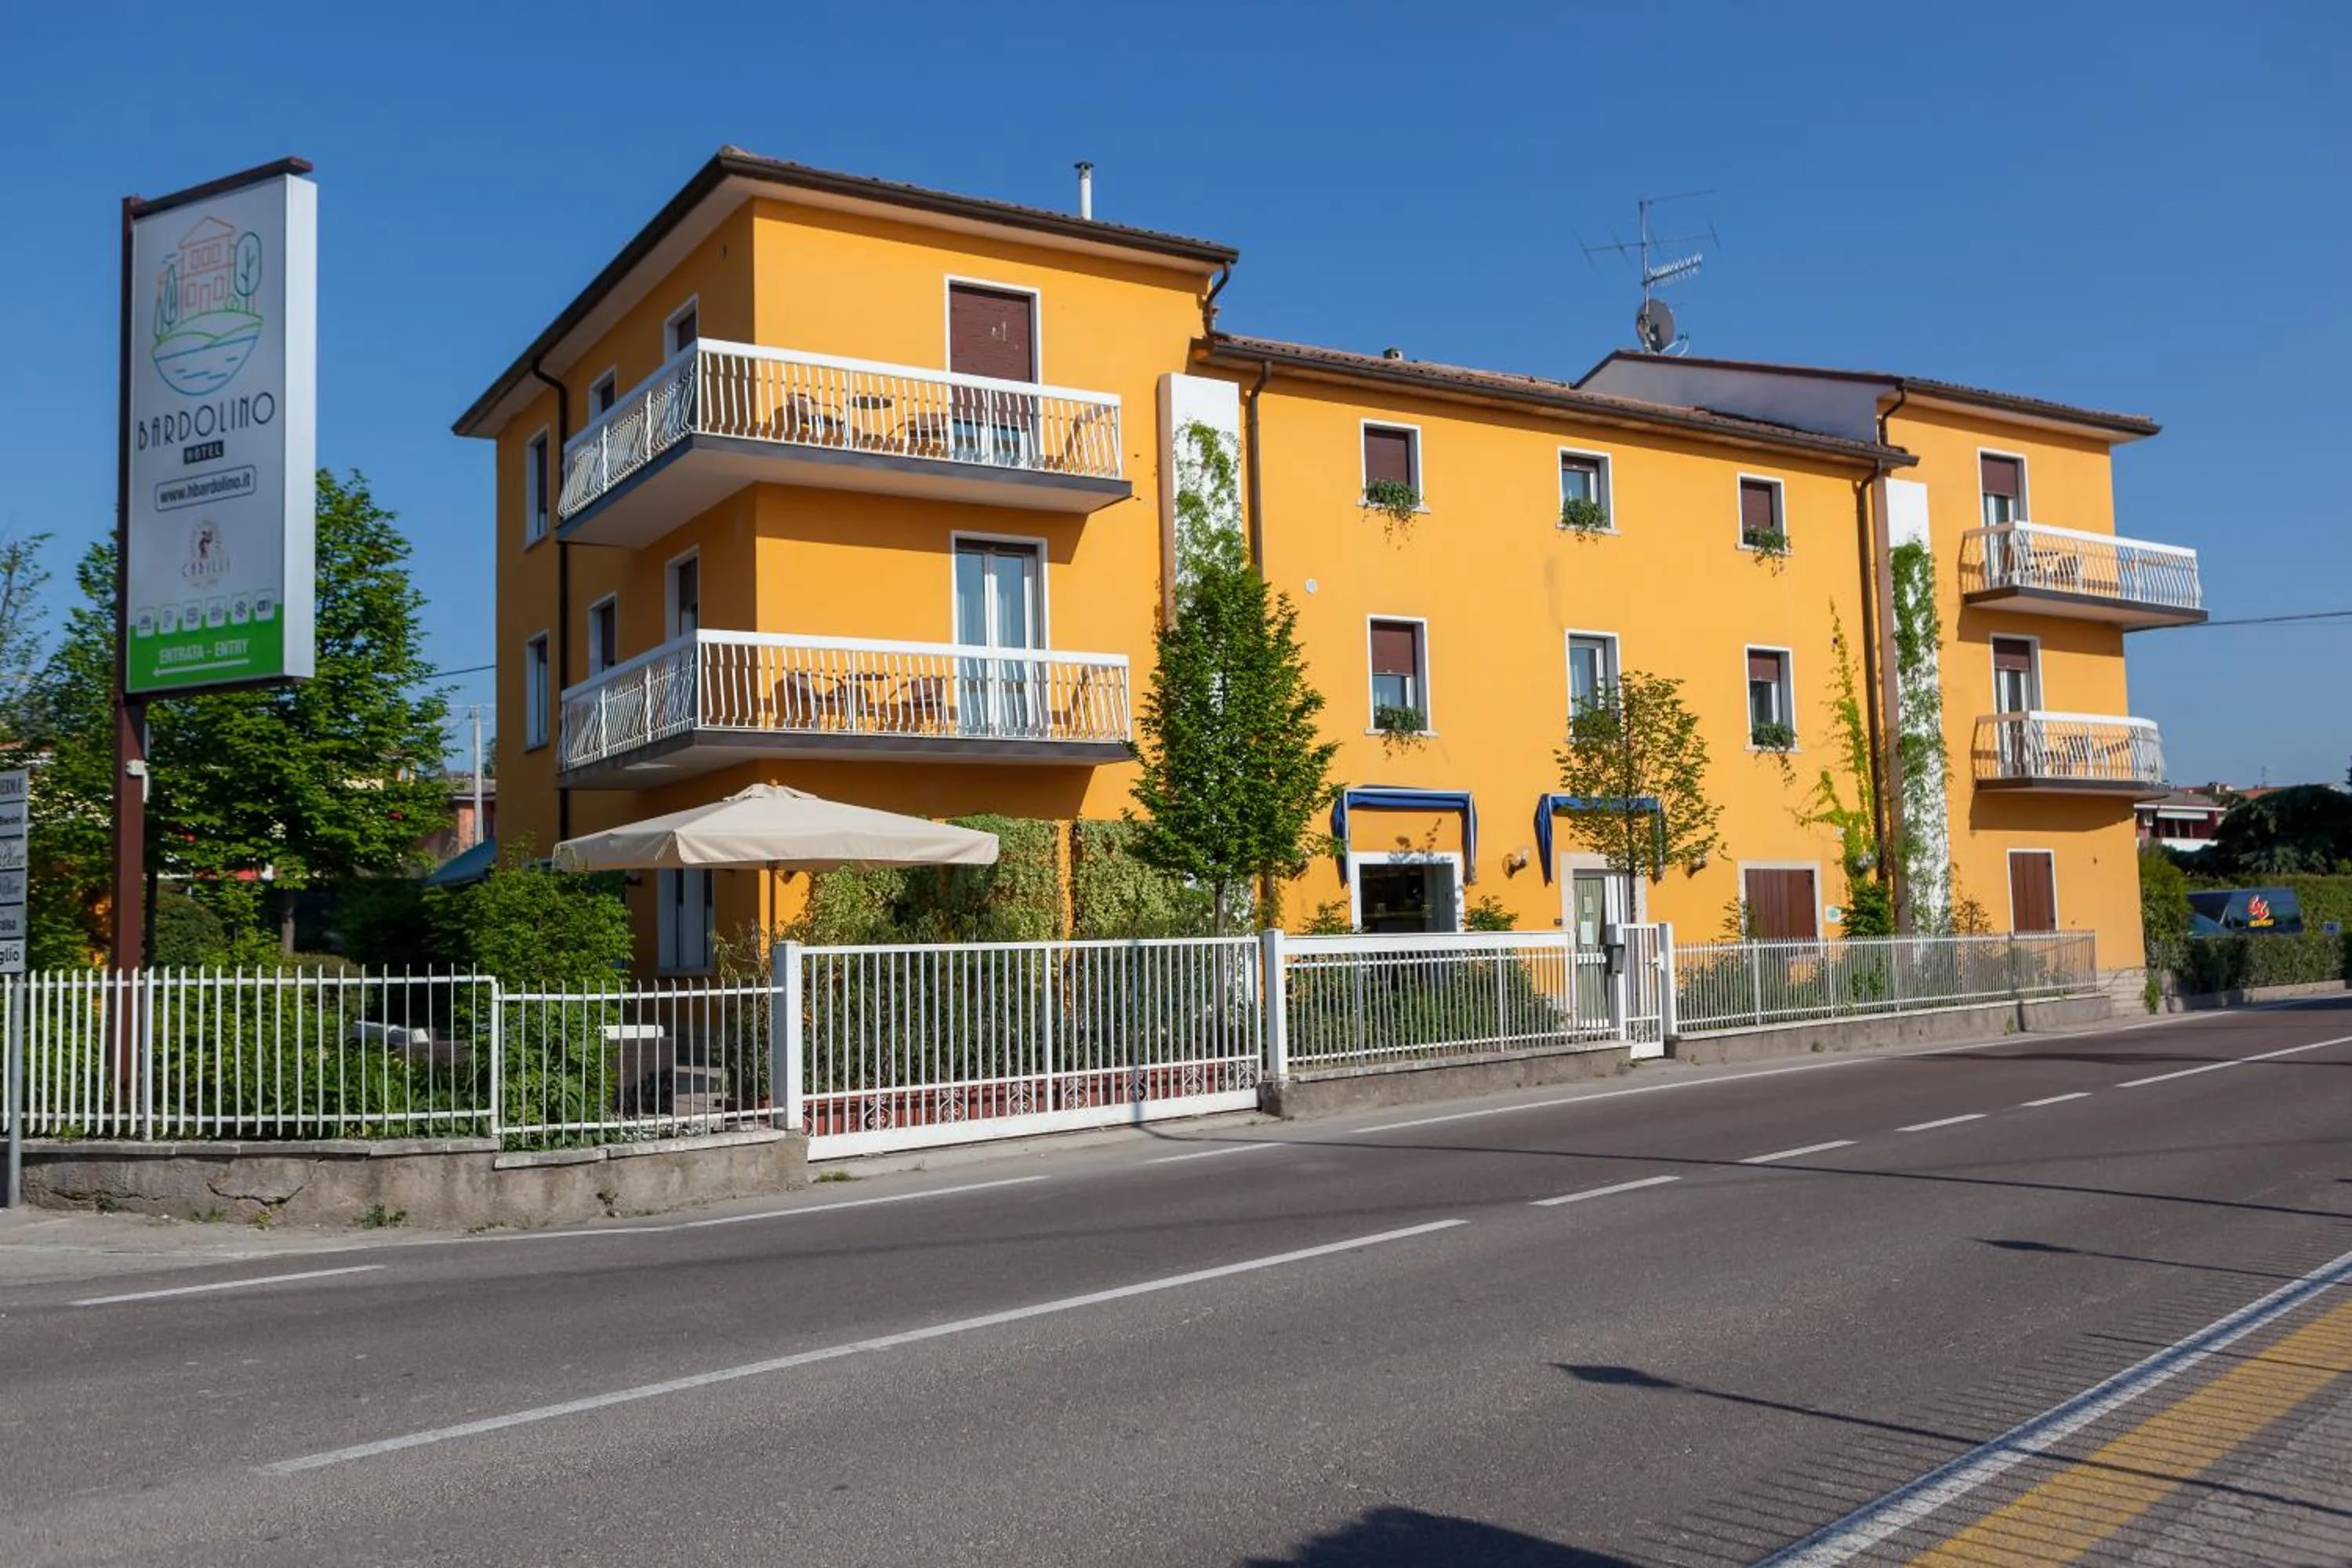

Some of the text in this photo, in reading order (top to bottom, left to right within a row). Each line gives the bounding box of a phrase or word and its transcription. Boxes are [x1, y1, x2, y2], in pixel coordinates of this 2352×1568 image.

[138, 391, 275, 452] BARDOLINO
[185, 442, 223, 461] HOTEL
[160, 472, 251, 503] www.hbardolino.it
[159, 644, 204, 664] ENTRATA
[214, 638, 249, 658] ENTRY
